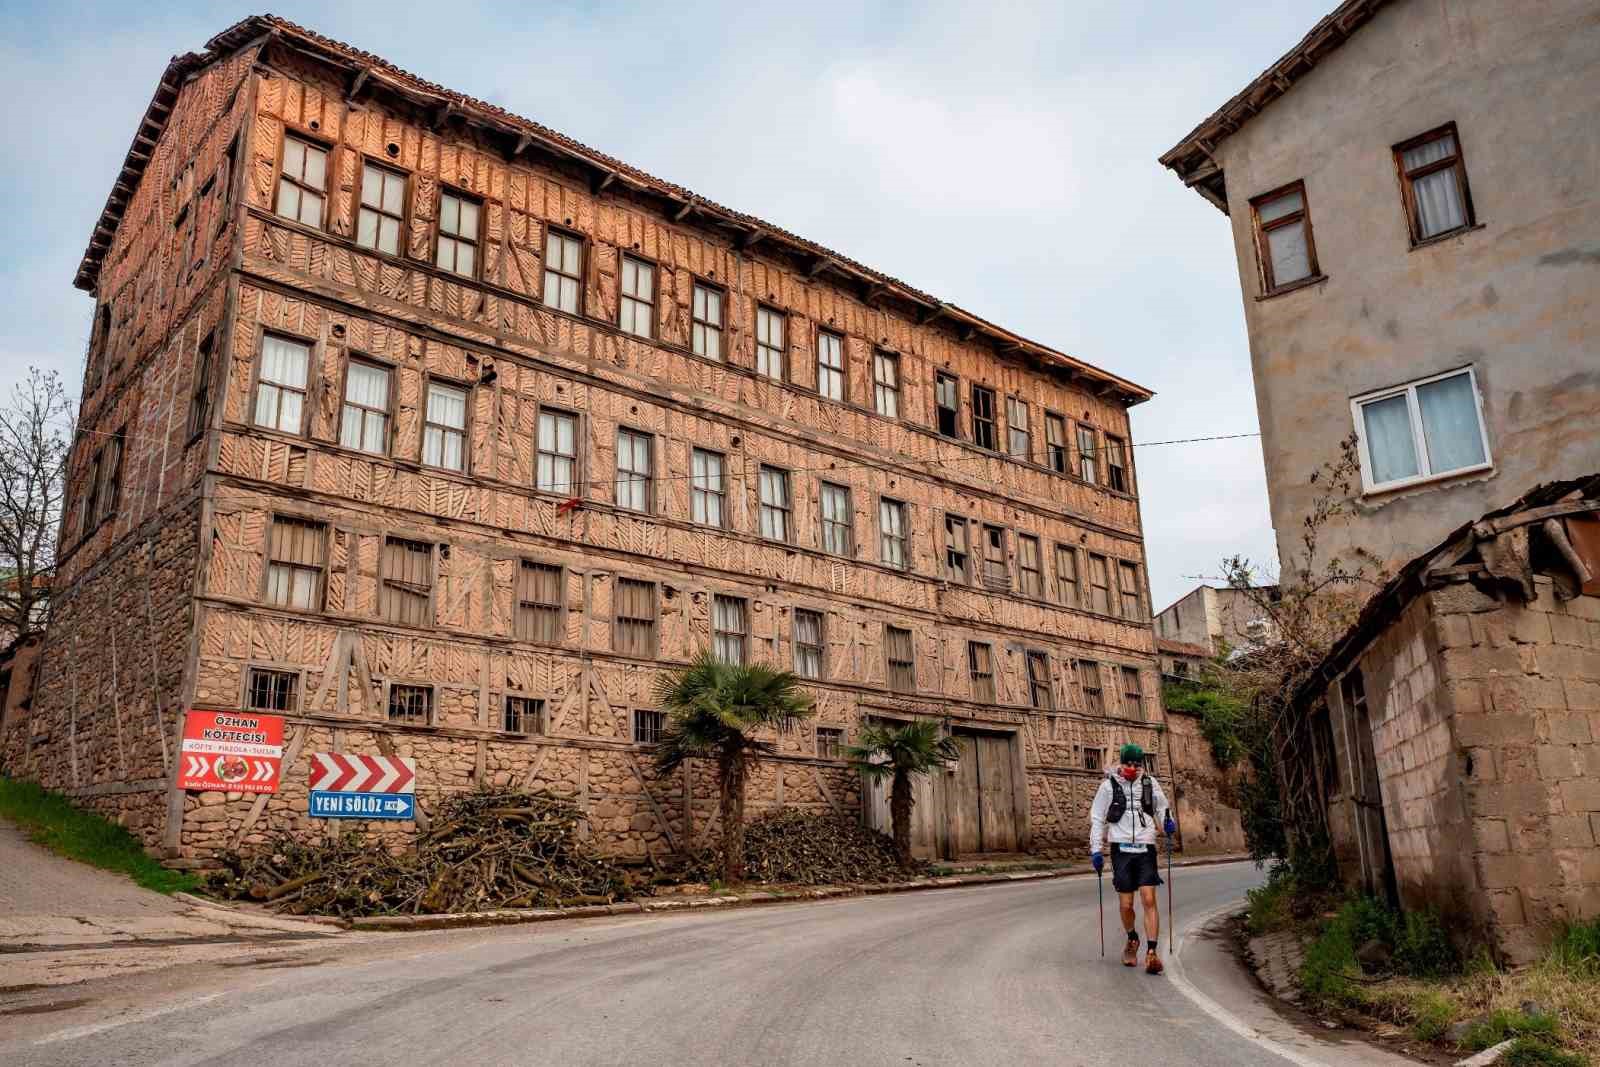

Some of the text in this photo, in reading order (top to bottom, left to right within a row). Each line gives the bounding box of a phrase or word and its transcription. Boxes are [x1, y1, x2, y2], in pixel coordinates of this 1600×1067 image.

[216, 714, 257, 728] ÖZHAN
[316, 795, 343, 811] YENİ
[345, 796, 382, 812] SÖLÖZ
